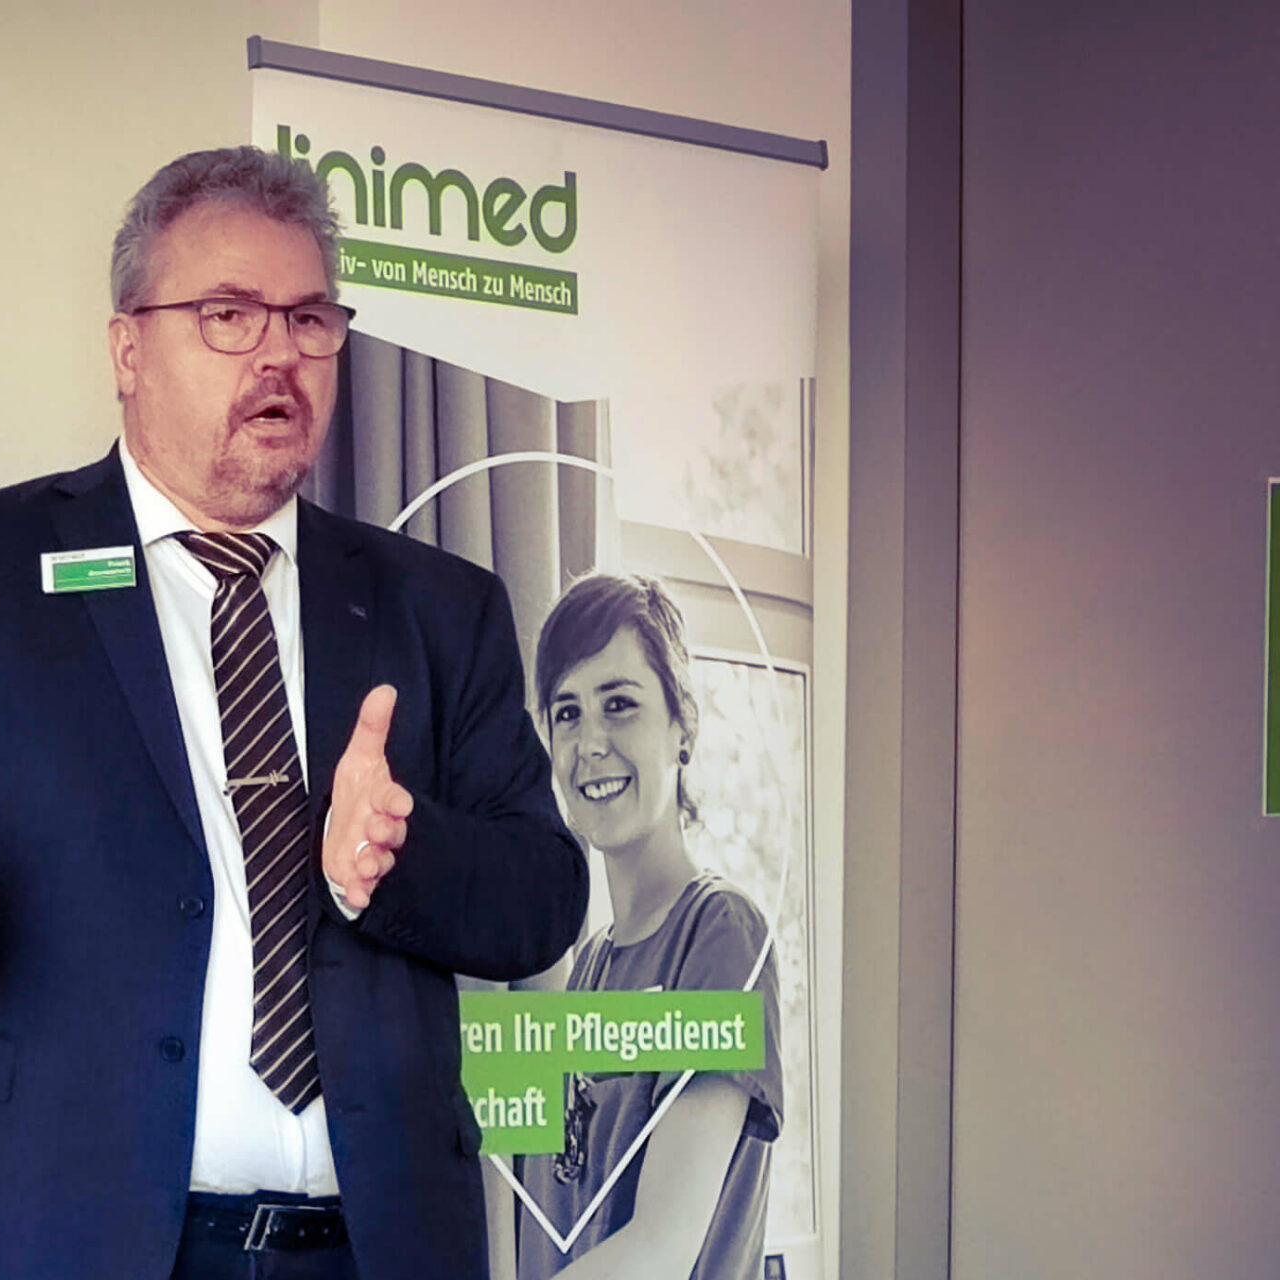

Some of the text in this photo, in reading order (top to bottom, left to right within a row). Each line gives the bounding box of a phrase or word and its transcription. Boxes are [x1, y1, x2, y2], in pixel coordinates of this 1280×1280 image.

[277, 124, 577, 253] nimed
[372, 259, 406, 282] von
[412, 260, 477, 293] Mensch
[483, 275, 503, 296] zu
[510, 275, 571, 306] Mensch
[514, 1012, 556, 1052] Ihr
[566, 1011, 745, 1061] Pflegedienst
[468, 1086, 547, 1128] chaft
